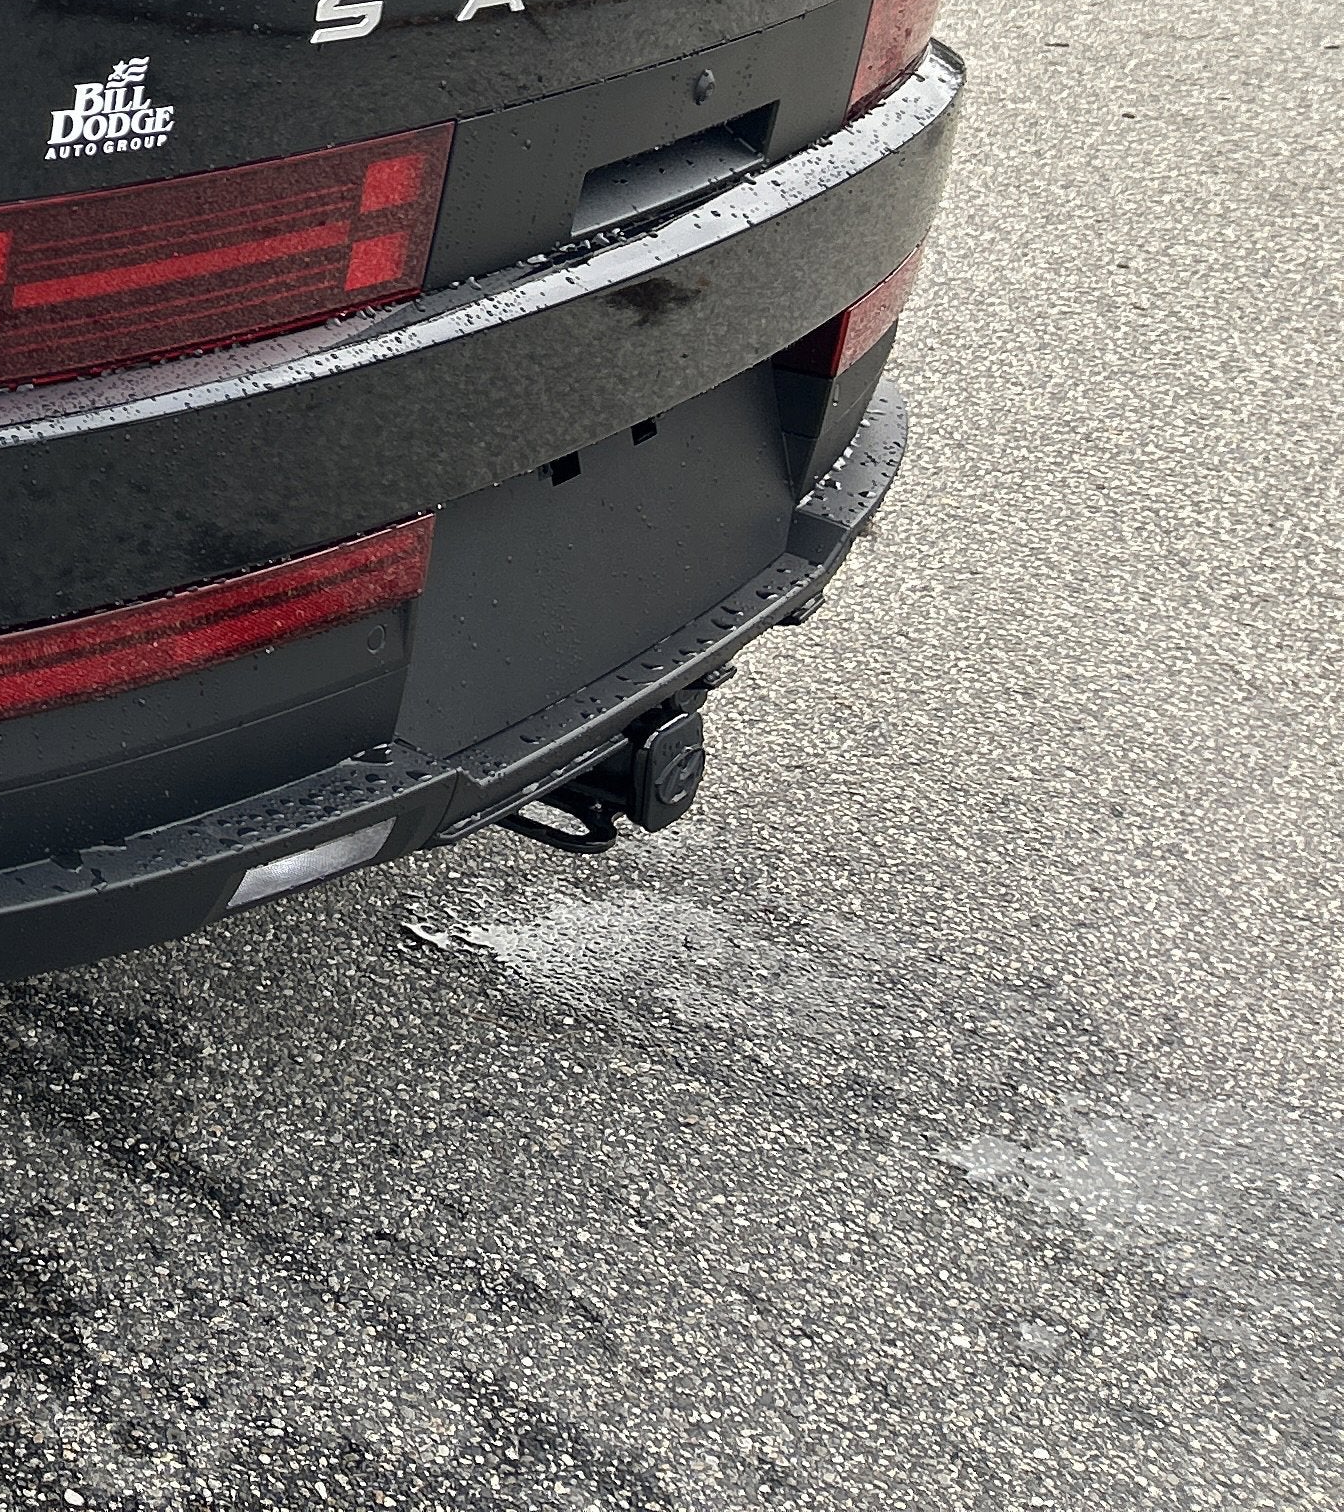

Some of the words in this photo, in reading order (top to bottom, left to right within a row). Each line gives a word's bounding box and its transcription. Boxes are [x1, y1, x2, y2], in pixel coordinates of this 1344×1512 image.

[74, 82, 152, 116] BILL
[47, 105, 175, 145] DODGE
[44, 142, 97, 160] AUTO
[103, 134, 168, 154] GROUP
